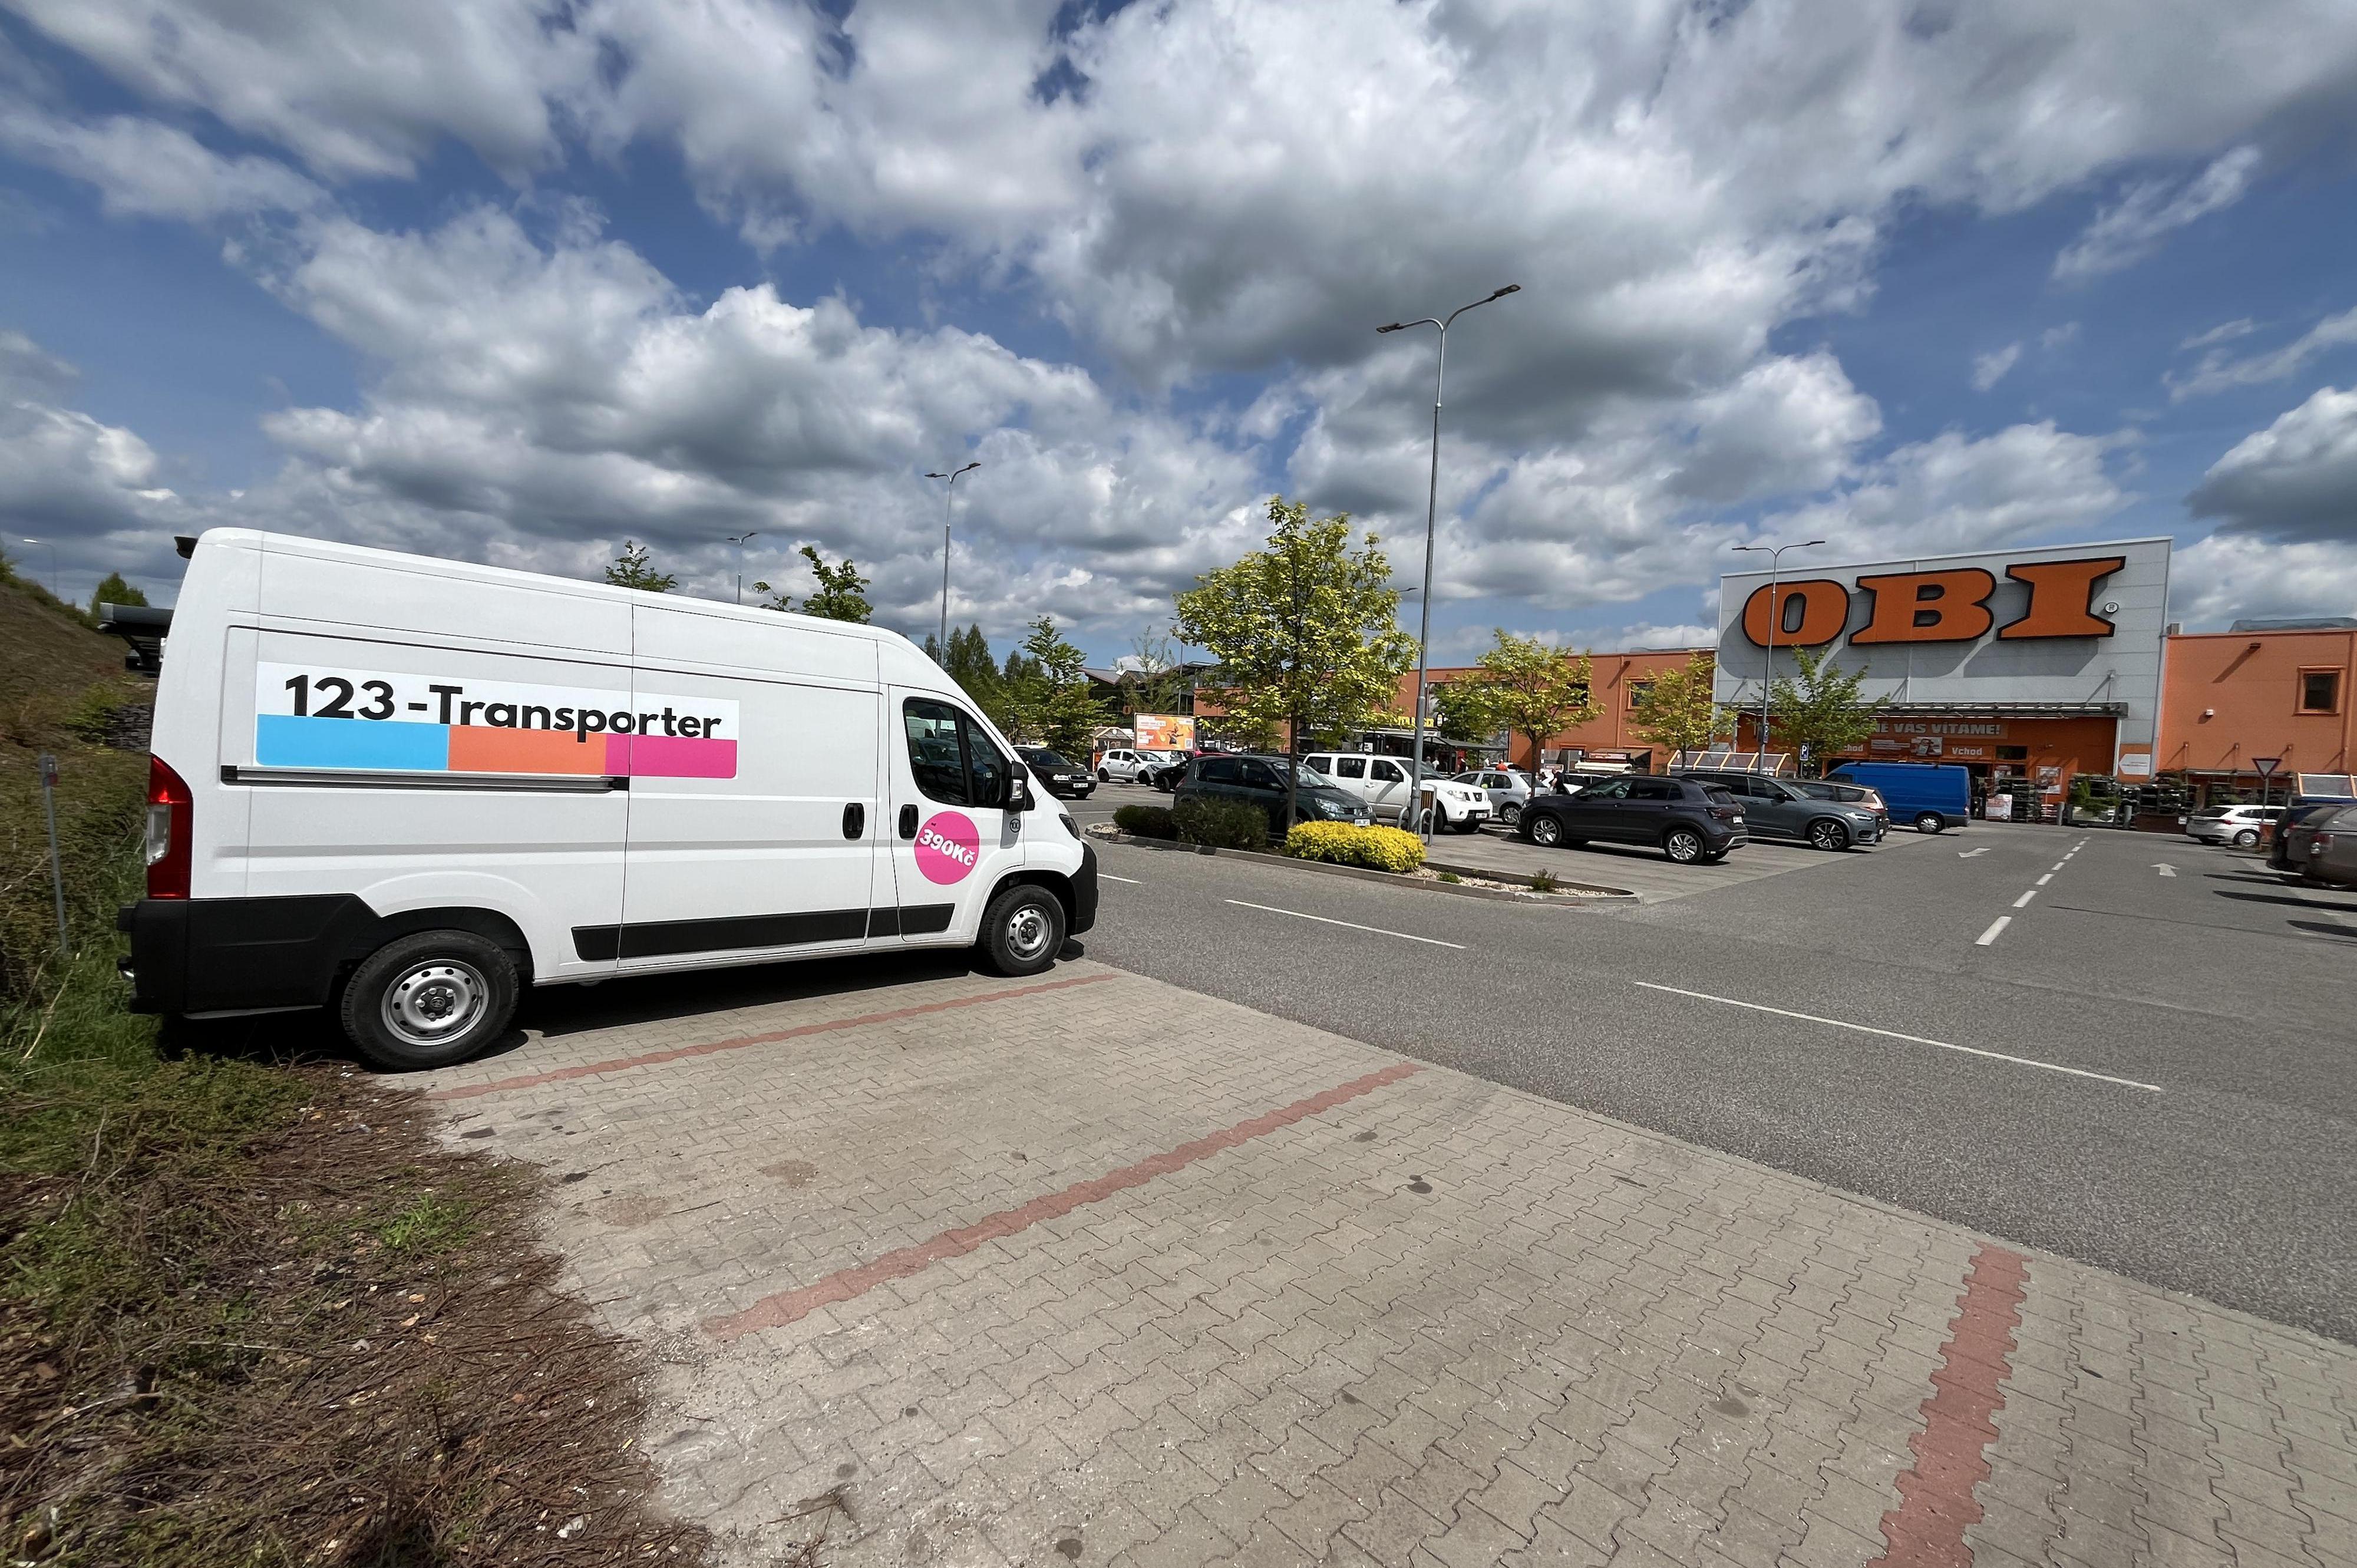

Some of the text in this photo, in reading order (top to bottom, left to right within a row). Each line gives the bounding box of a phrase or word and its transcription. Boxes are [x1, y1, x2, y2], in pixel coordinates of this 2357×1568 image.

[1742, 556, 2127, 648] OBI
[1951, 747, 1983, 755] Vchod
[919, 828, 976, 866] 390Kč
